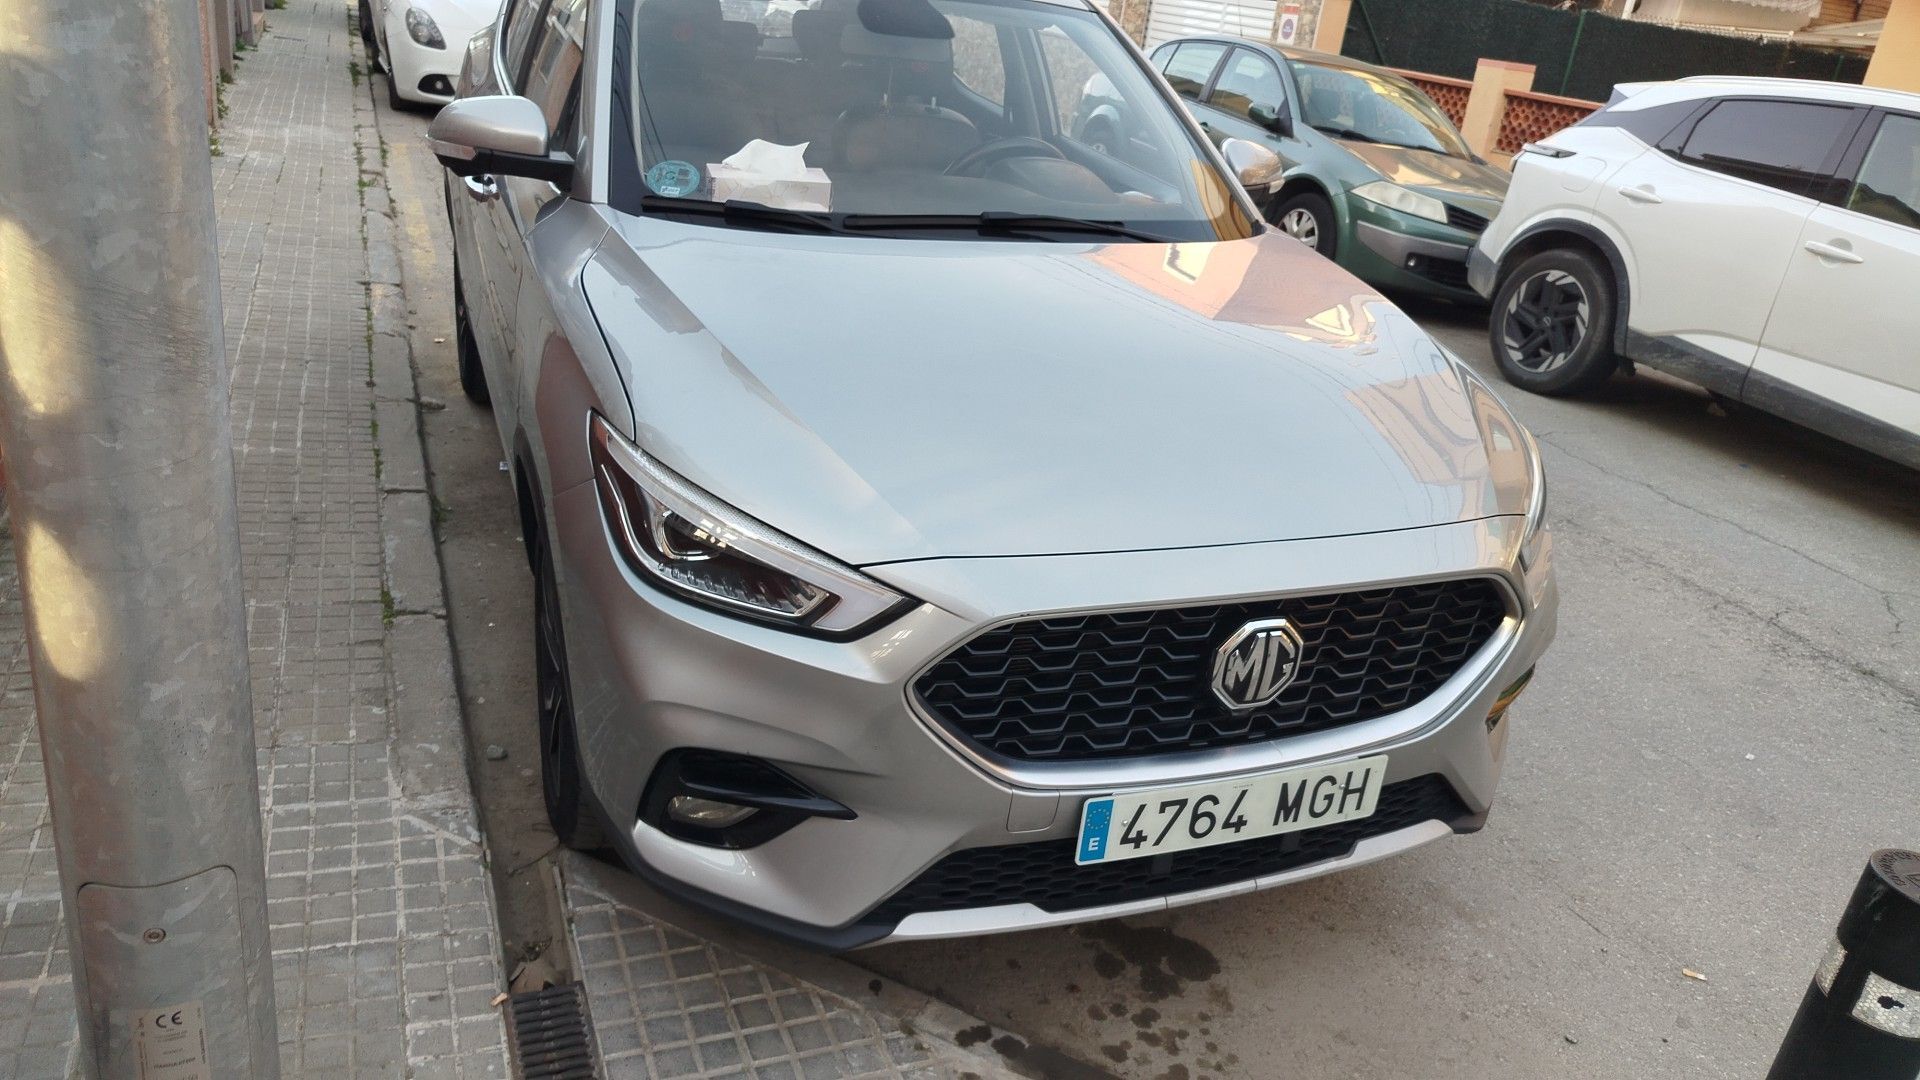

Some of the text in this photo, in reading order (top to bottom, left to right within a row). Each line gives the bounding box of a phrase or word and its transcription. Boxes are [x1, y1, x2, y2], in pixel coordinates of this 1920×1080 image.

[1224, 631, 1296, 701] MG
[1087, 767, 1372, 851] E 4764 MGH
[155, 1010, 183, 1028] CE
